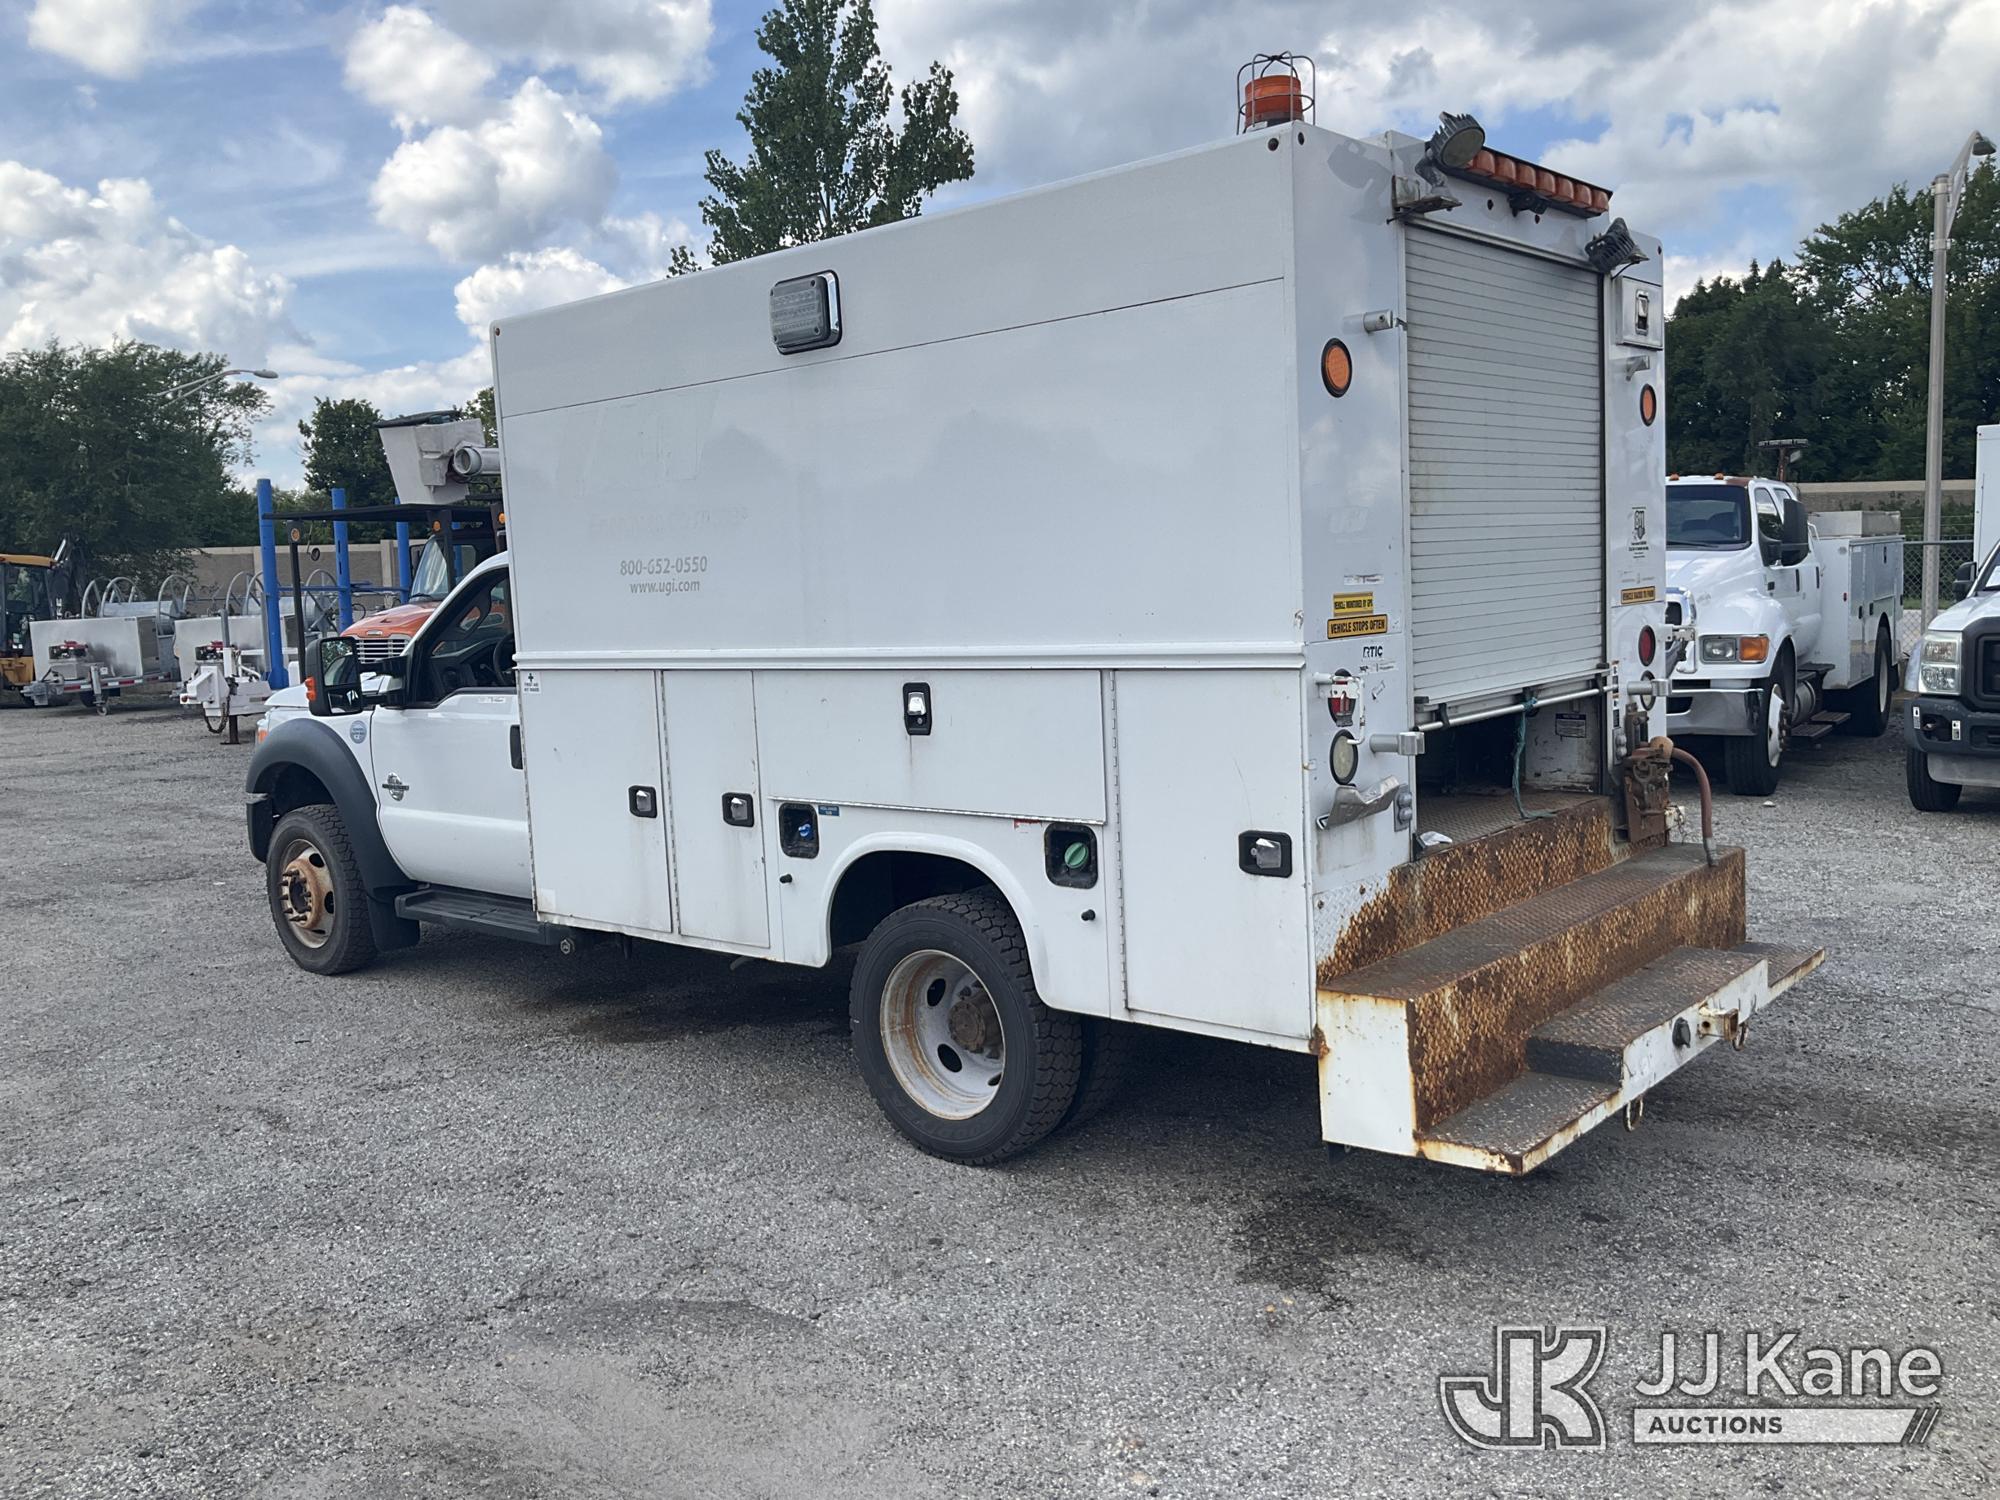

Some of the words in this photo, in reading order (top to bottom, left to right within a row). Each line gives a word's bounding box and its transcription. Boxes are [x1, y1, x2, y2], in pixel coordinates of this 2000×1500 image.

[620, 556, 707, 576] 800-652-0550
[630, 578, 700, 596] www.ugi.com
[1331, 622, 1352, 634] VEHICLE
[1353, 621, 1368, 632] STOPS
[1370, 619, 1385, 630] OFTEN
